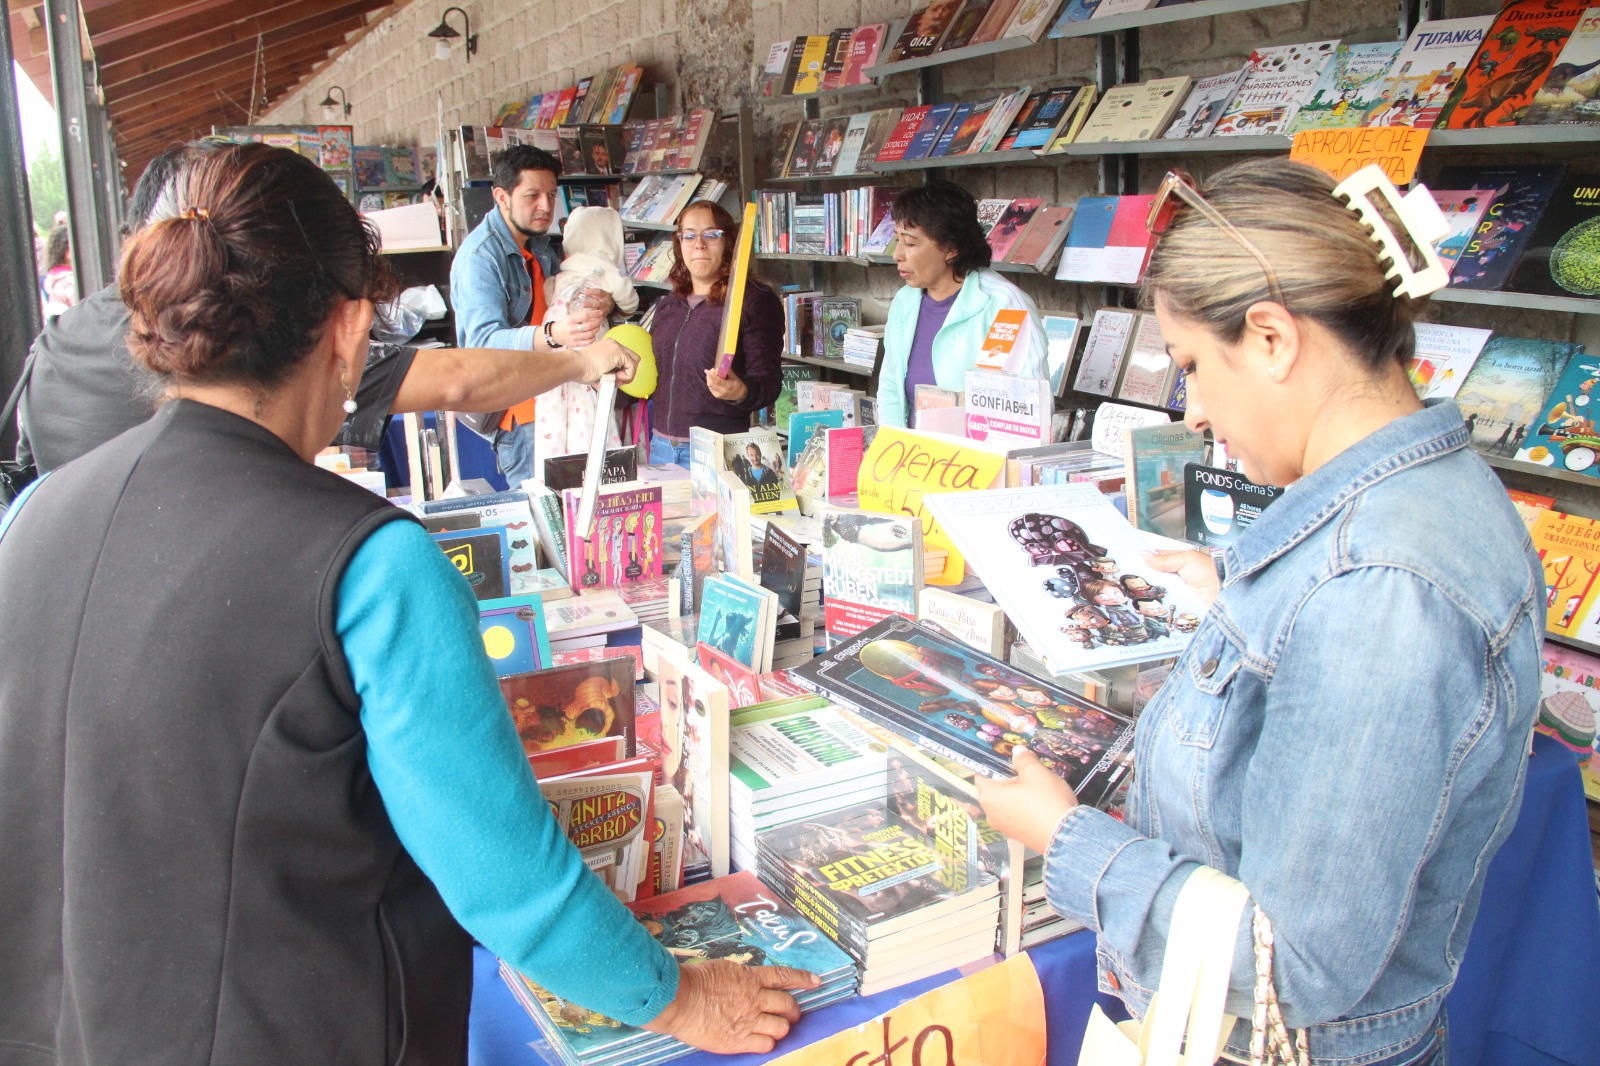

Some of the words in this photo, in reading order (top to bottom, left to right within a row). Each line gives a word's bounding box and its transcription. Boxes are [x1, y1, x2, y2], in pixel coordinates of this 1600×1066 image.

[1505, 5, 1593, 22] Dinosaur
[1413, 28, 1485, 51] TUTANKA
[1239, 79, 1313, 91] OMPARACIONES
[901, 111, 927, 122] VIDAS
[907, 122, 918, 130] DE
[903, 131, 915, 139] LOS
[1296, 129, 1416, 156] APROVECHE
[884, 140, 910, 150] ESTOICOS
[1573, 187, 1600, 199] UNI
[988, 331, 1016, 342] TARJETAS
[782, 370, 801, 378] EAN
[1504, 361, 1523, 371] hora
[1524, 364, 1544, 373] azul
[781, 381, 797, 391] AU
[1100, 405, 1145, 428] Oferta
[969, 421, 989, 432] GRATIS
[989, 420, 1013, 432] EJEMPLAR
[1019, 426, 1038, 436] DIGITAL
[725, 438, 746, 447] NICK
[1151, 432, 1184, 445] Oficinas
[602, 465, 626, 477] PAPA
[872, 440, 980, 489] Oferta
[601, 475, 627, 485] CISCO
[760, 481, 789, 492] ALMA
[859, 479, 879, 498] desde
[1195, 470, 1233, 489] POND'S
[1234, 479, 1266, 496] Crema
[1557, 523, 1600, 541] JUEGO
[824, 550, 863, 567] MARI
[825, 566, 914, 586] JUNGSTEDT
[825, 579, 878, 599] RUBEN
[928, 601, 950, 618] Caldo
[957, 609, 977, 626] Pollo
[965, 627, 987, 644] Alma
[570, 791, 627, 828] ANITA
[574, 815, 604, 834] SECRET
[606, 801, 636, 819] AGENCY
[571, 806, 641, 848] GARBO'S
[863, 824, 902, 843] DONOVAN
[587, 854, 612, 867] ARECIDOS
[819, 835, 926, 882] FITNESS
[842, 849, 938, 891] PRETEXTOS
